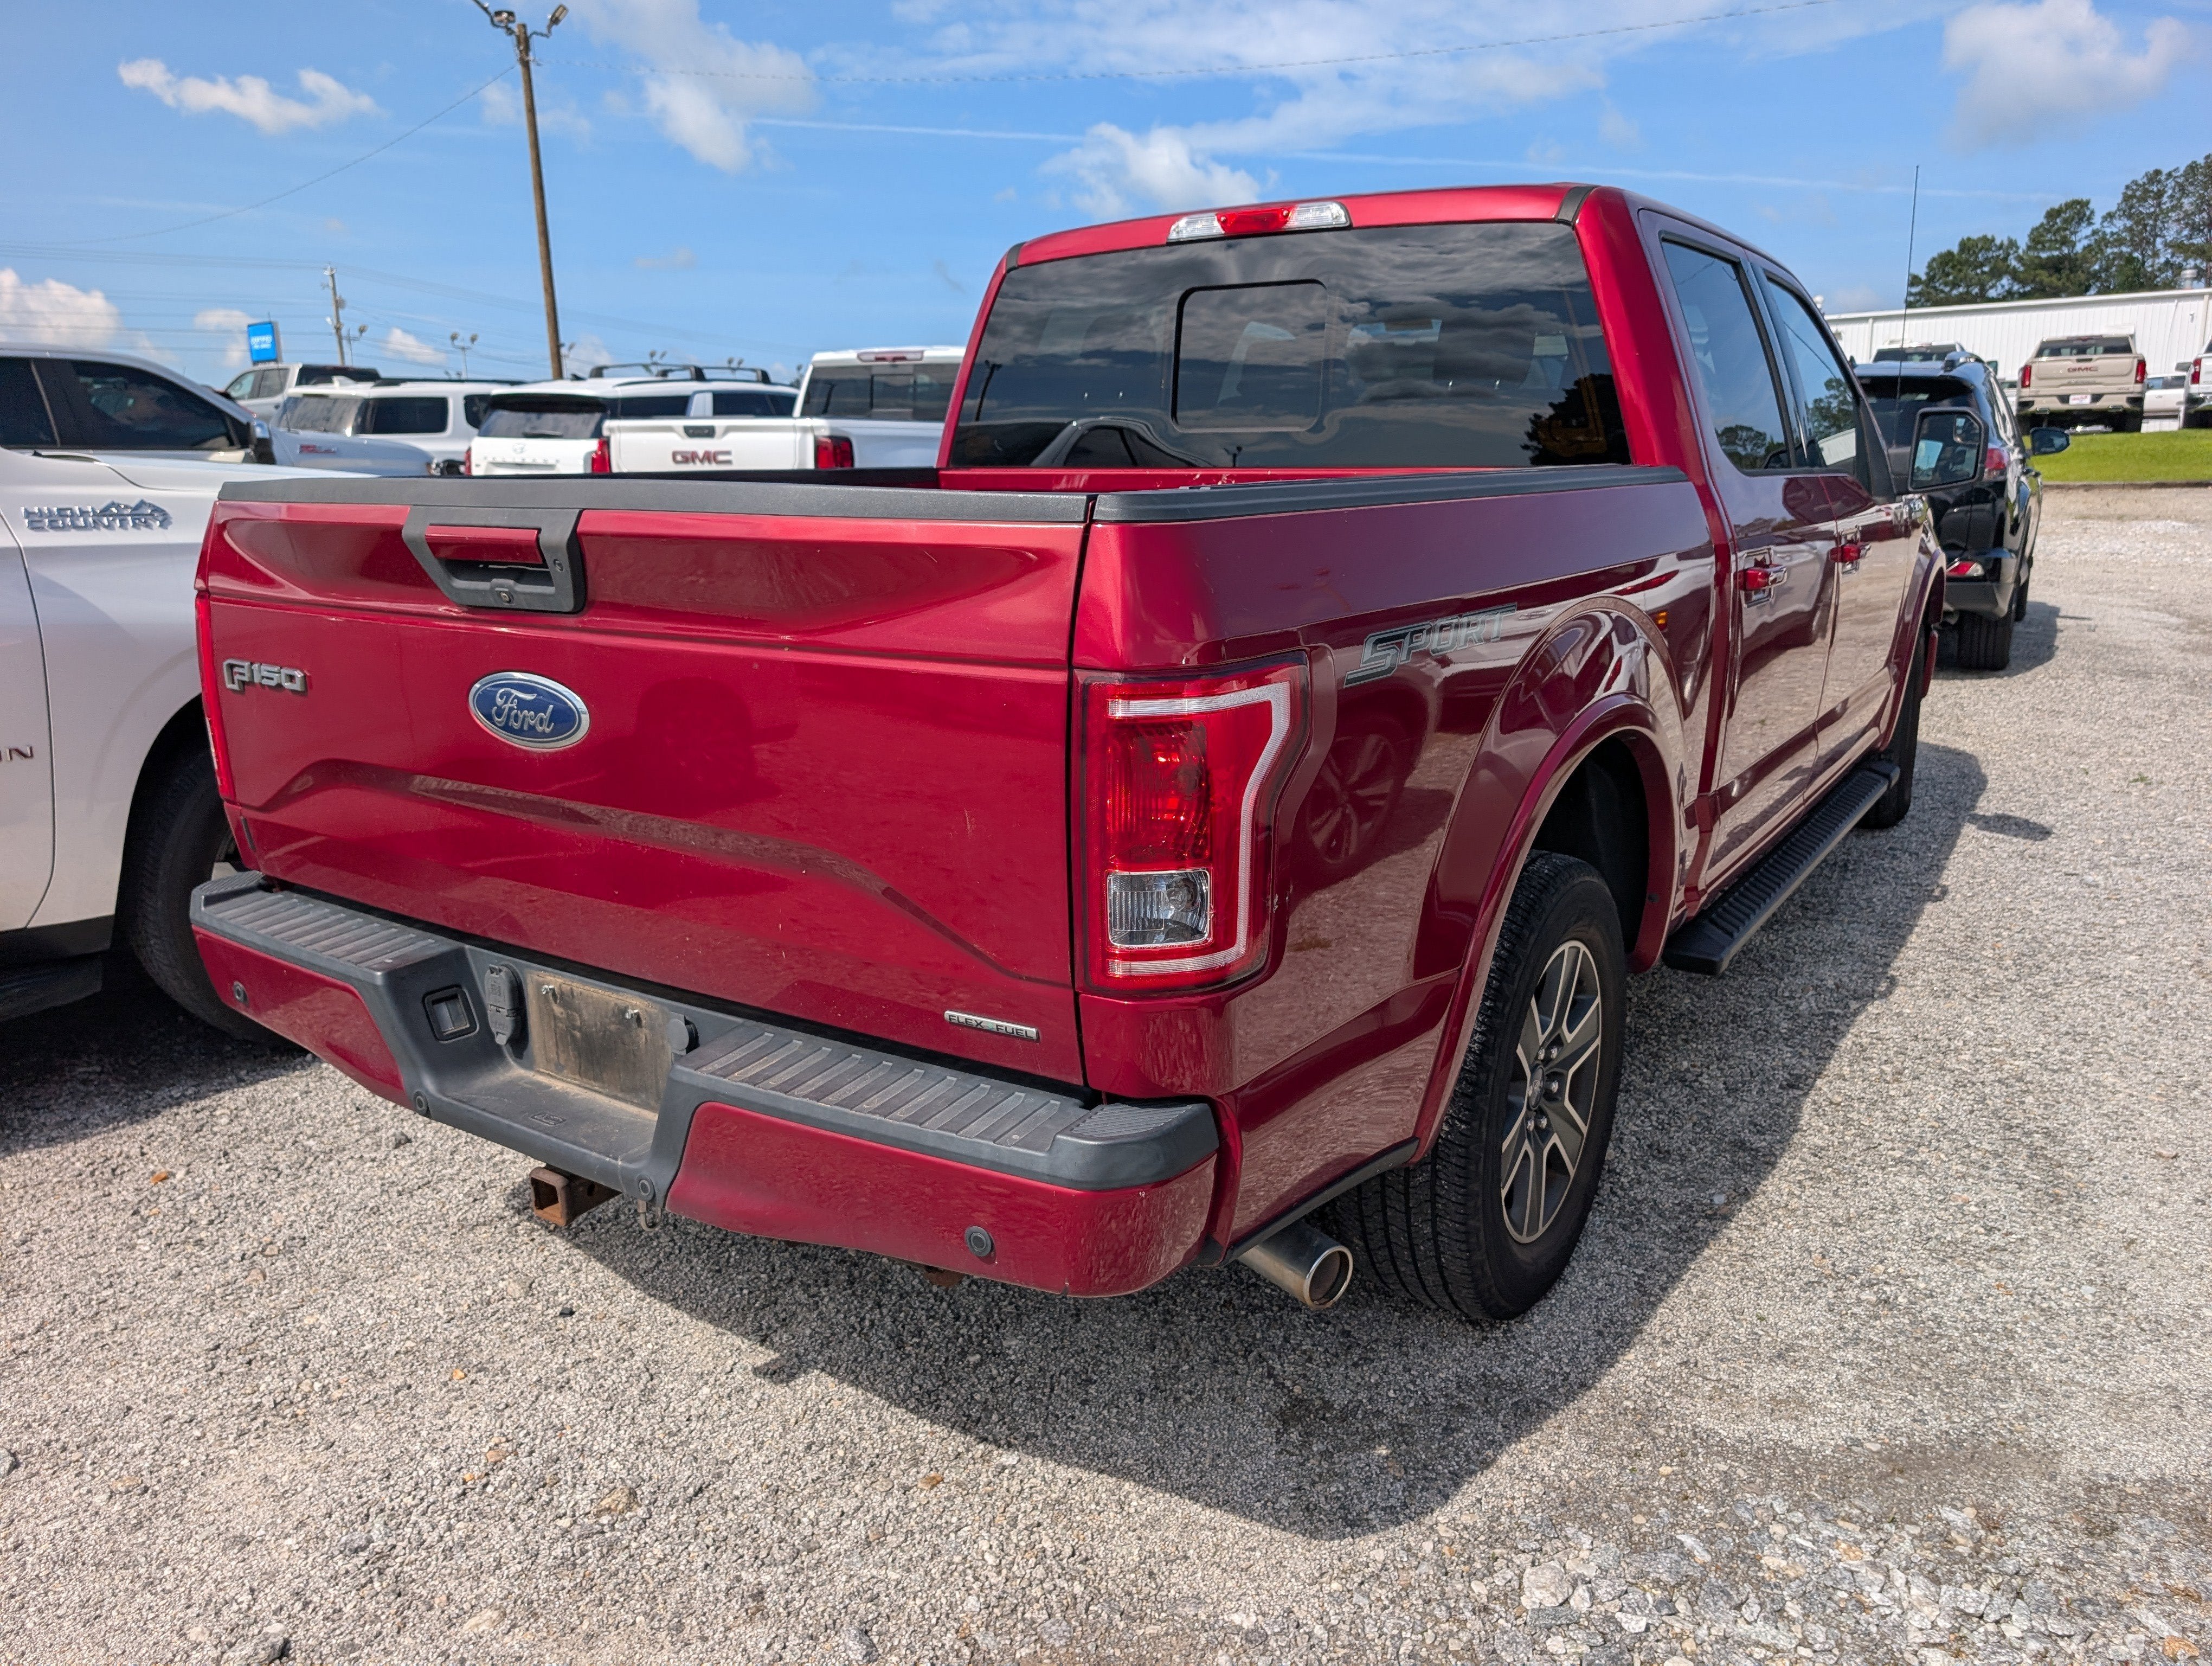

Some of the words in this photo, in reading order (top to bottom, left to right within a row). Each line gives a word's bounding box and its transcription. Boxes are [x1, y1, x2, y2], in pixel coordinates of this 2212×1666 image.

[672, 450, 732, 465] GMC
[25, 516, 170, 531] COUNTRY
[1343, 602, 1517, 688] SPORT
[492, 687, 555, 733] Ford
[948, 1014, 985, 1029] FLEX
[995, 1024, 1034, 1039] FUEL
